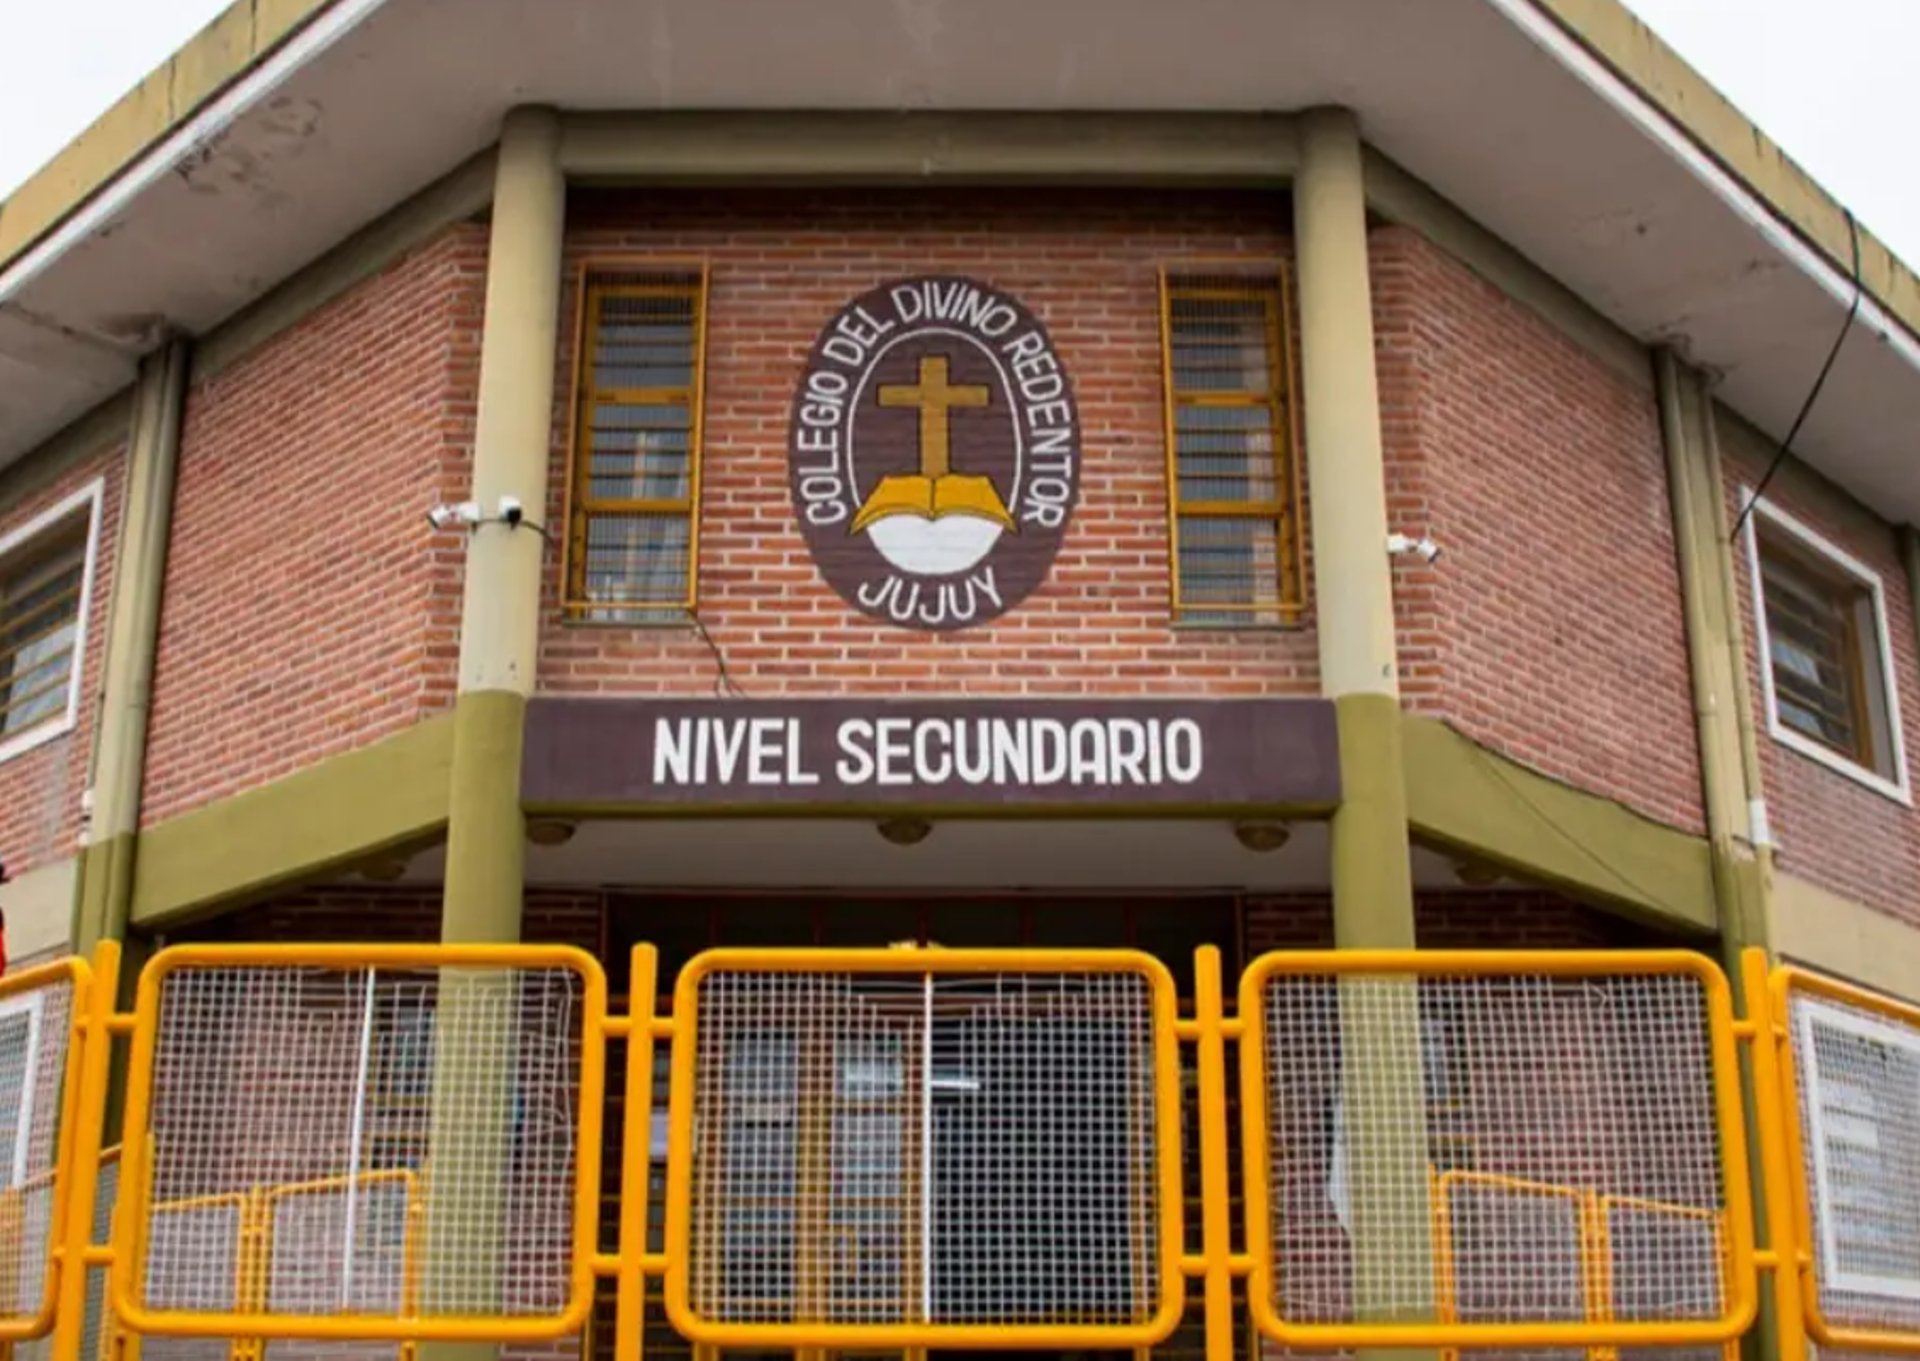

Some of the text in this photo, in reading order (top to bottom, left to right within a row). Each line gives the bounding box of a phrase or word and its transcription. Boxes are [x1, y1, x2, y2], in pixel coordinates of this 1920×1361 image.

[797, 280, 1072, 528] COLEGIO DEL DIVINO REDENTOR
[857, 566, 1003, 624] JUJUY
[653, 717, 1204, 785] NIVEL SECUNDARIO
